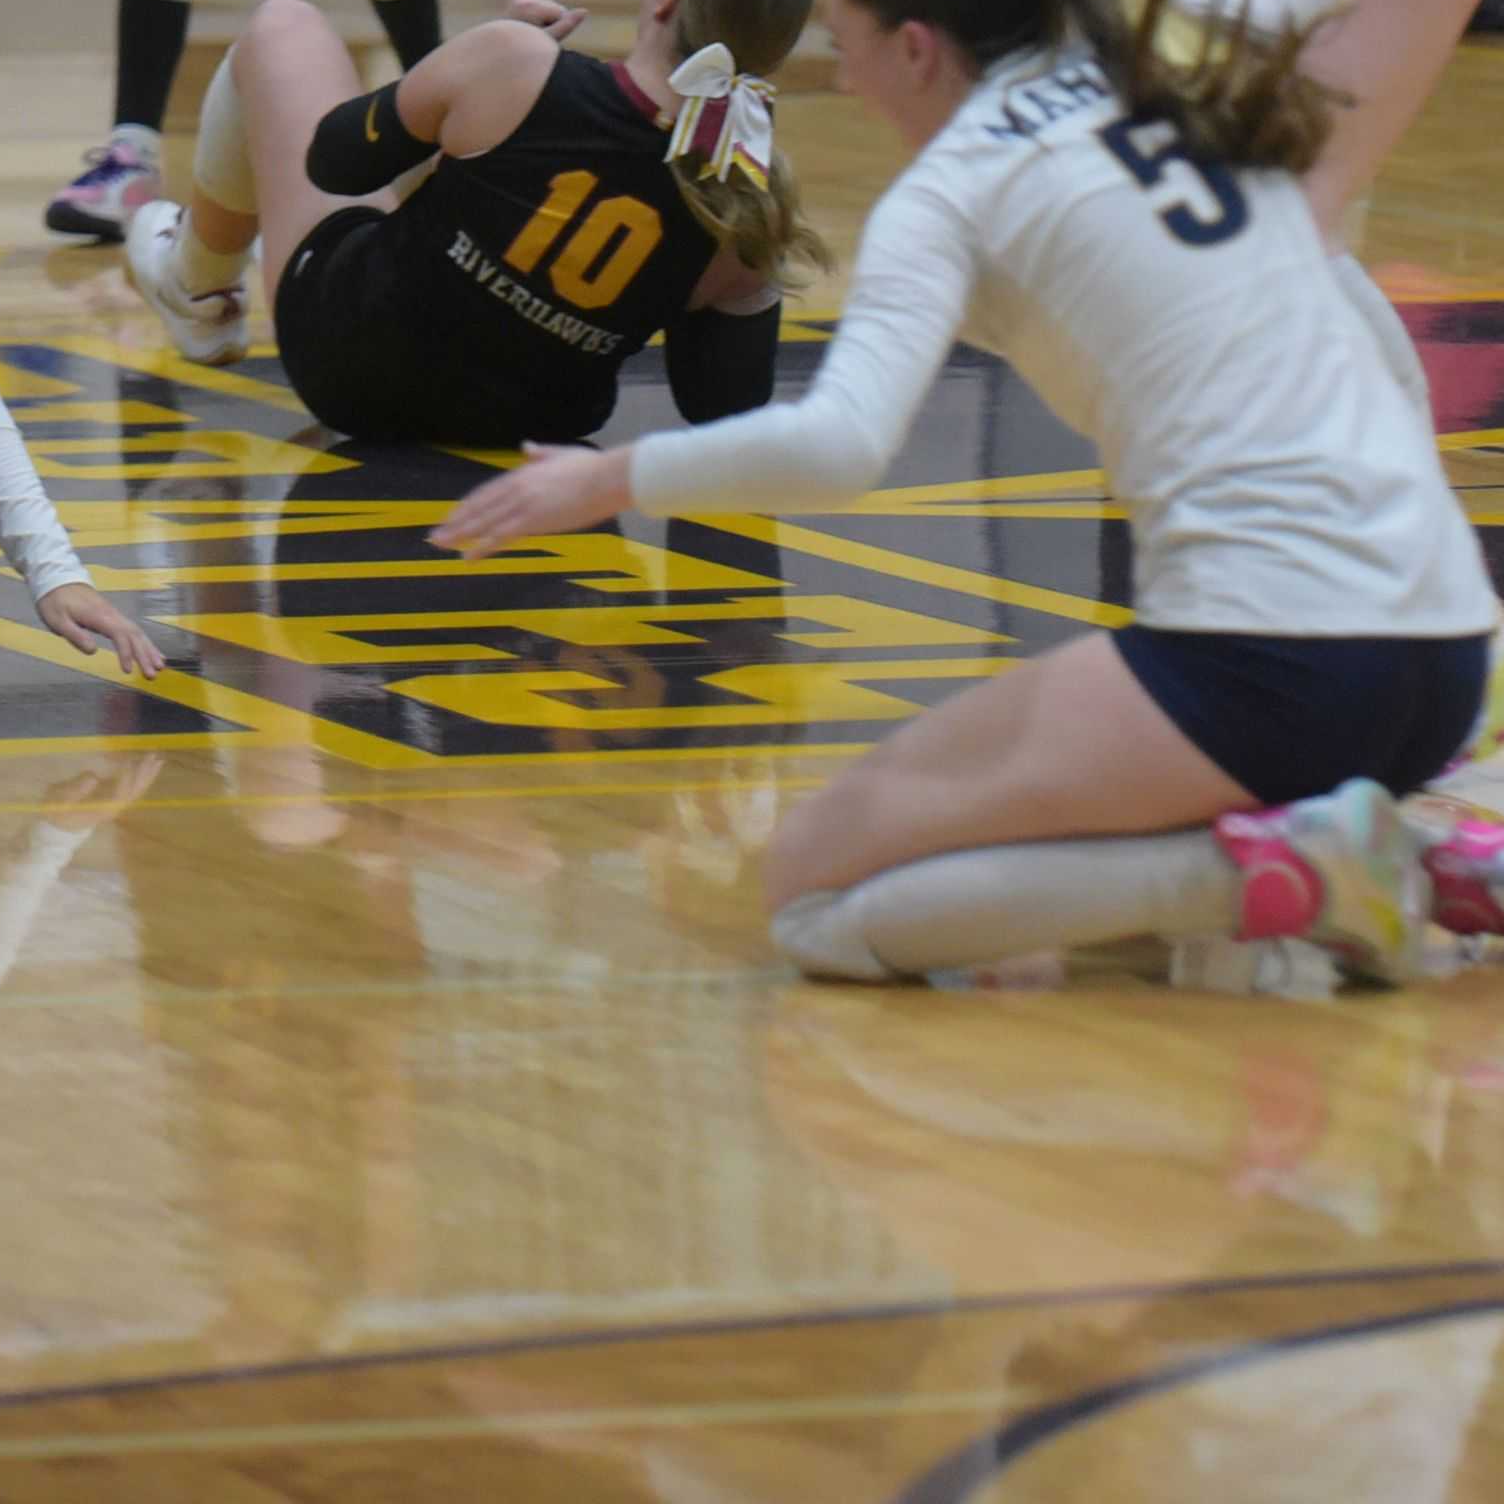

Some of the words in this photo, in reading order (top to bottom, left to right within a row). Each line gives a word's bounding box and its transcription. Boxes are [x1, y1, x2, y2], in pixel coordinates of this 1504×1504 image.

[502, 168, 665, 310] 10
[1098, 101, 1250, 248] 5
[444, 230, 625, 357] RIVERHAWKS
